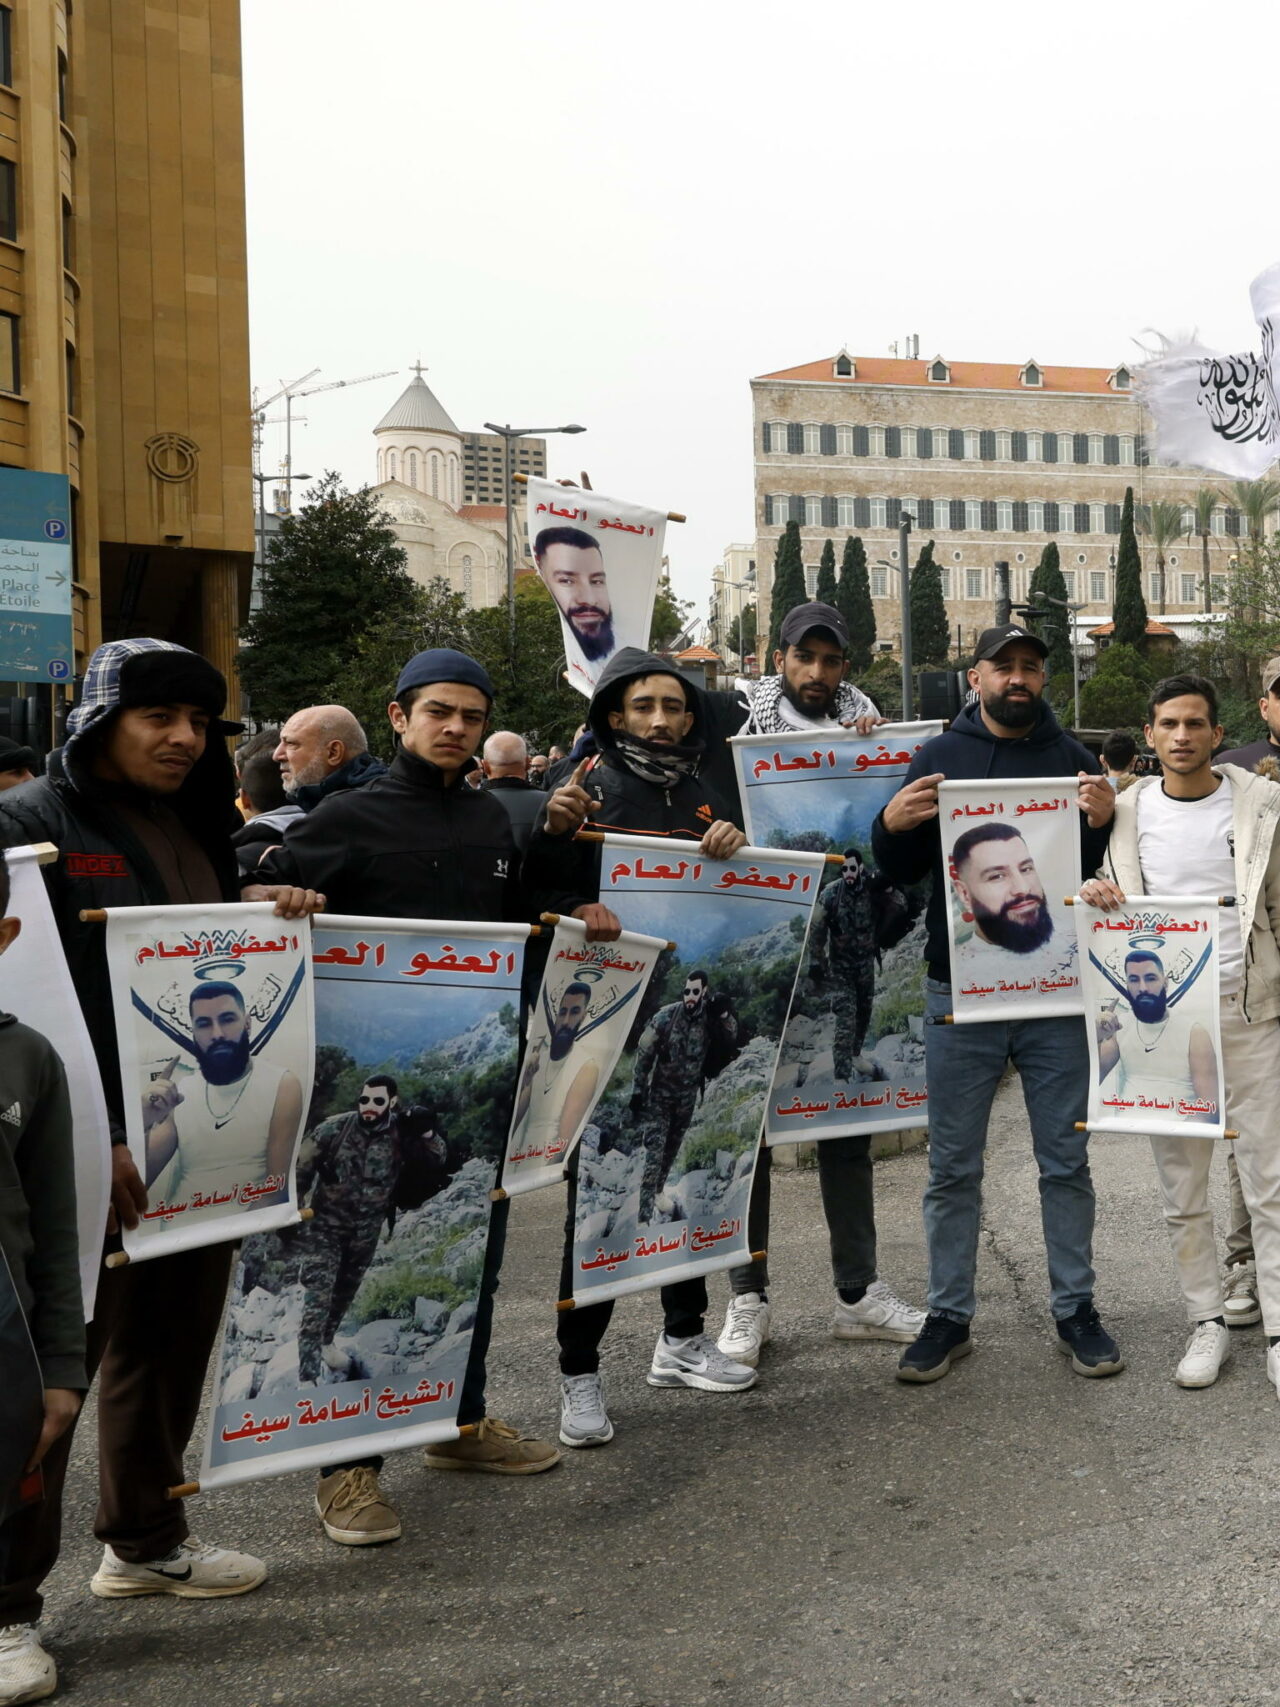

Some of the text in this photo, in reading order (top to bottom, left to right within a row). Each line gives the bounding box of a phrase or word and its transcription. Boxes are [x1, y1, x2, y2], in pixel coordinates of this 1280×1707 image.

[534, 502, 654, 537] العفو العام
[1, 545, 39, 557] ساحة
[0, 562, 39, 572] النجم
[2, 578, 40, 592] Place
[753, 750, 836, 778] العام
[951, 799, 1068, 821] العفو العام
[66, 857, 125, 873] INDEX
[610, 857, 811, 893] العفو العام
[1091, 918, 1208, 936] العفو العام
[136, 935, 299, 965] العفو العام
[400, 944, 515, 976] العفو
[555, 947, 646, 973] العفو العام
[960, 975, 1079, 997] الشيخ أسامة سيف
[776, 1095, 829, 1119] سيف
[833, 1086, 892, 1109] أسامة
[1102, 1094, 1216, 1114] الشيخ أسامة سيف
[142, 1173, 285, 1223] الشيخ أسامة سيف
[580, 1216, 741, 1272] الشيخ أسامة سيف
[222, 1378, 455, 1443] الشيخ أسامة سيف
